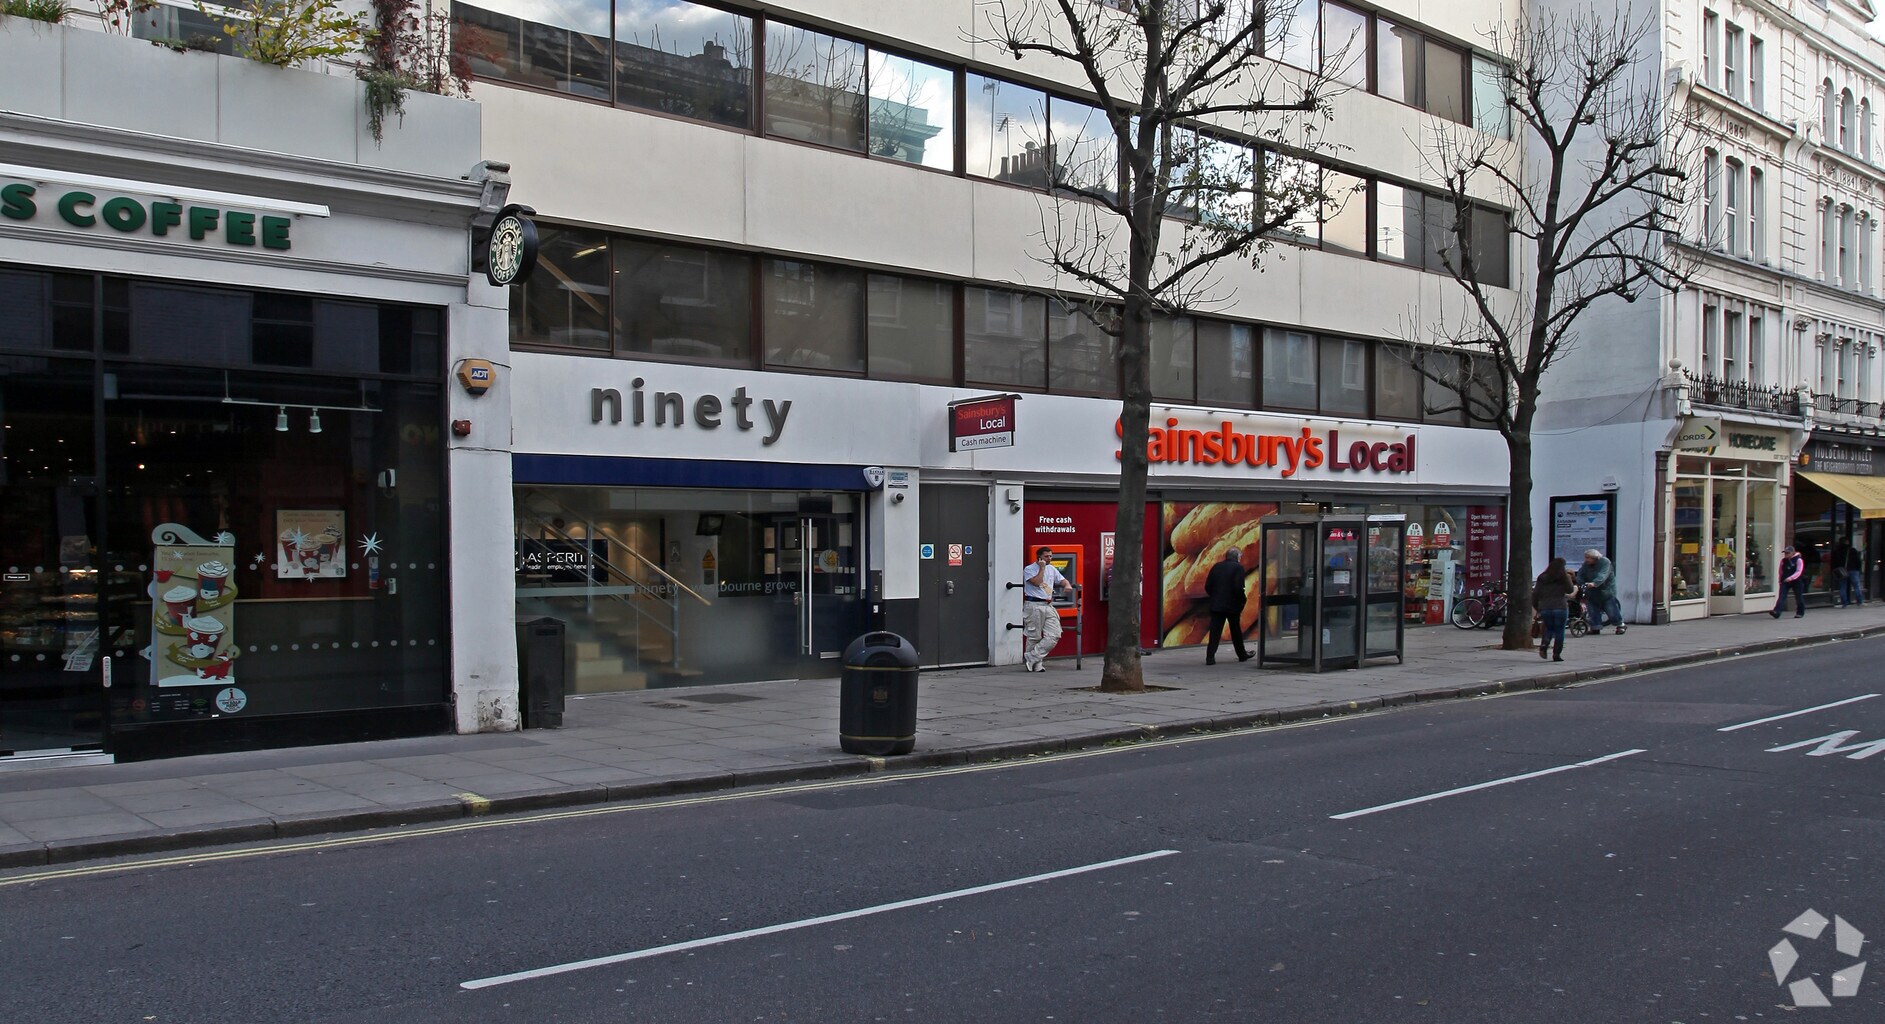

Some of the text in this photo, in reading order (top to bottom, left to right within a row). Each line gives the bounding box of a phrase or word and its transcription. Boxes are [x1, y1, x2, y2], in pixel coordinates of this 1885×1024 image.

[58, 191, 292, 250] COFFEE
[493, 261, 518, 280] COFFEE
[472, 370, 488, 378] ADT
[591, 377, 793, 446] ninety
[958, 405, 1006, 420] Sainsbury's
[980, 416, 1006, 430] Local
[961, 435, 1007, 447] Cash machine
[1679, 433, 1706, 442] LORDS
[1729, 432, 1777, 452] HOMECARE
[1115, 417, 1416, 477] ainsbury's Local
[1039, 516, 1072, 524] Free cash
[1035, 525, 1076, 533] withdrawals
[528, 552, 594, 563] ASPERIT
[764, 579, 797, 595] grove
